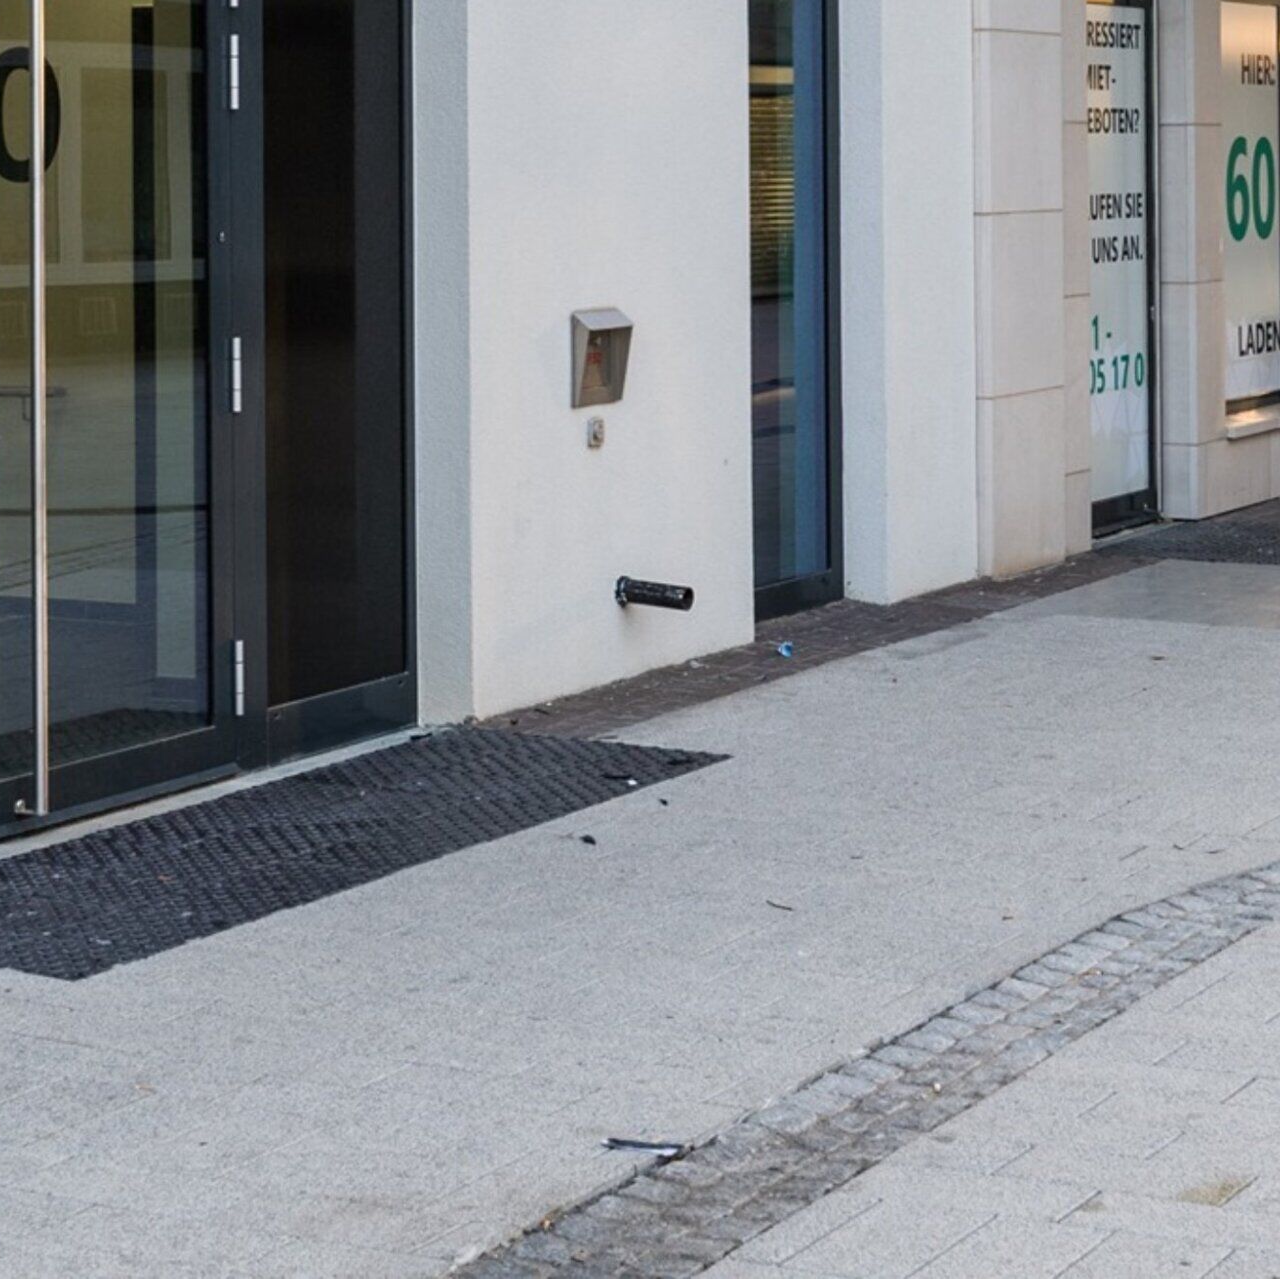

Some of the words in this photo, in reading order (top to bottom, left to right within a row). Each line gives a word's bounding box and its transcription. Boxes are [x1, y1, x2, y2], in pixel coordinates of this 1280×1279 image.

[1086, 20, 1141, 50] RESSIERT
[1241, 54, 1276, 86] HIER:
[1087, 107, 1140, 134] EBOTEN?
[1226, 136, 1276, 241] 60
[1089, 192, 1122, 221] UFEN
[1125, 192, 1143, 219] SIE
[1091, 236, 1119, 264] UNS
[1121, 234, 1144, 262] AN.
[1112, 354, 1130, 391] 17
